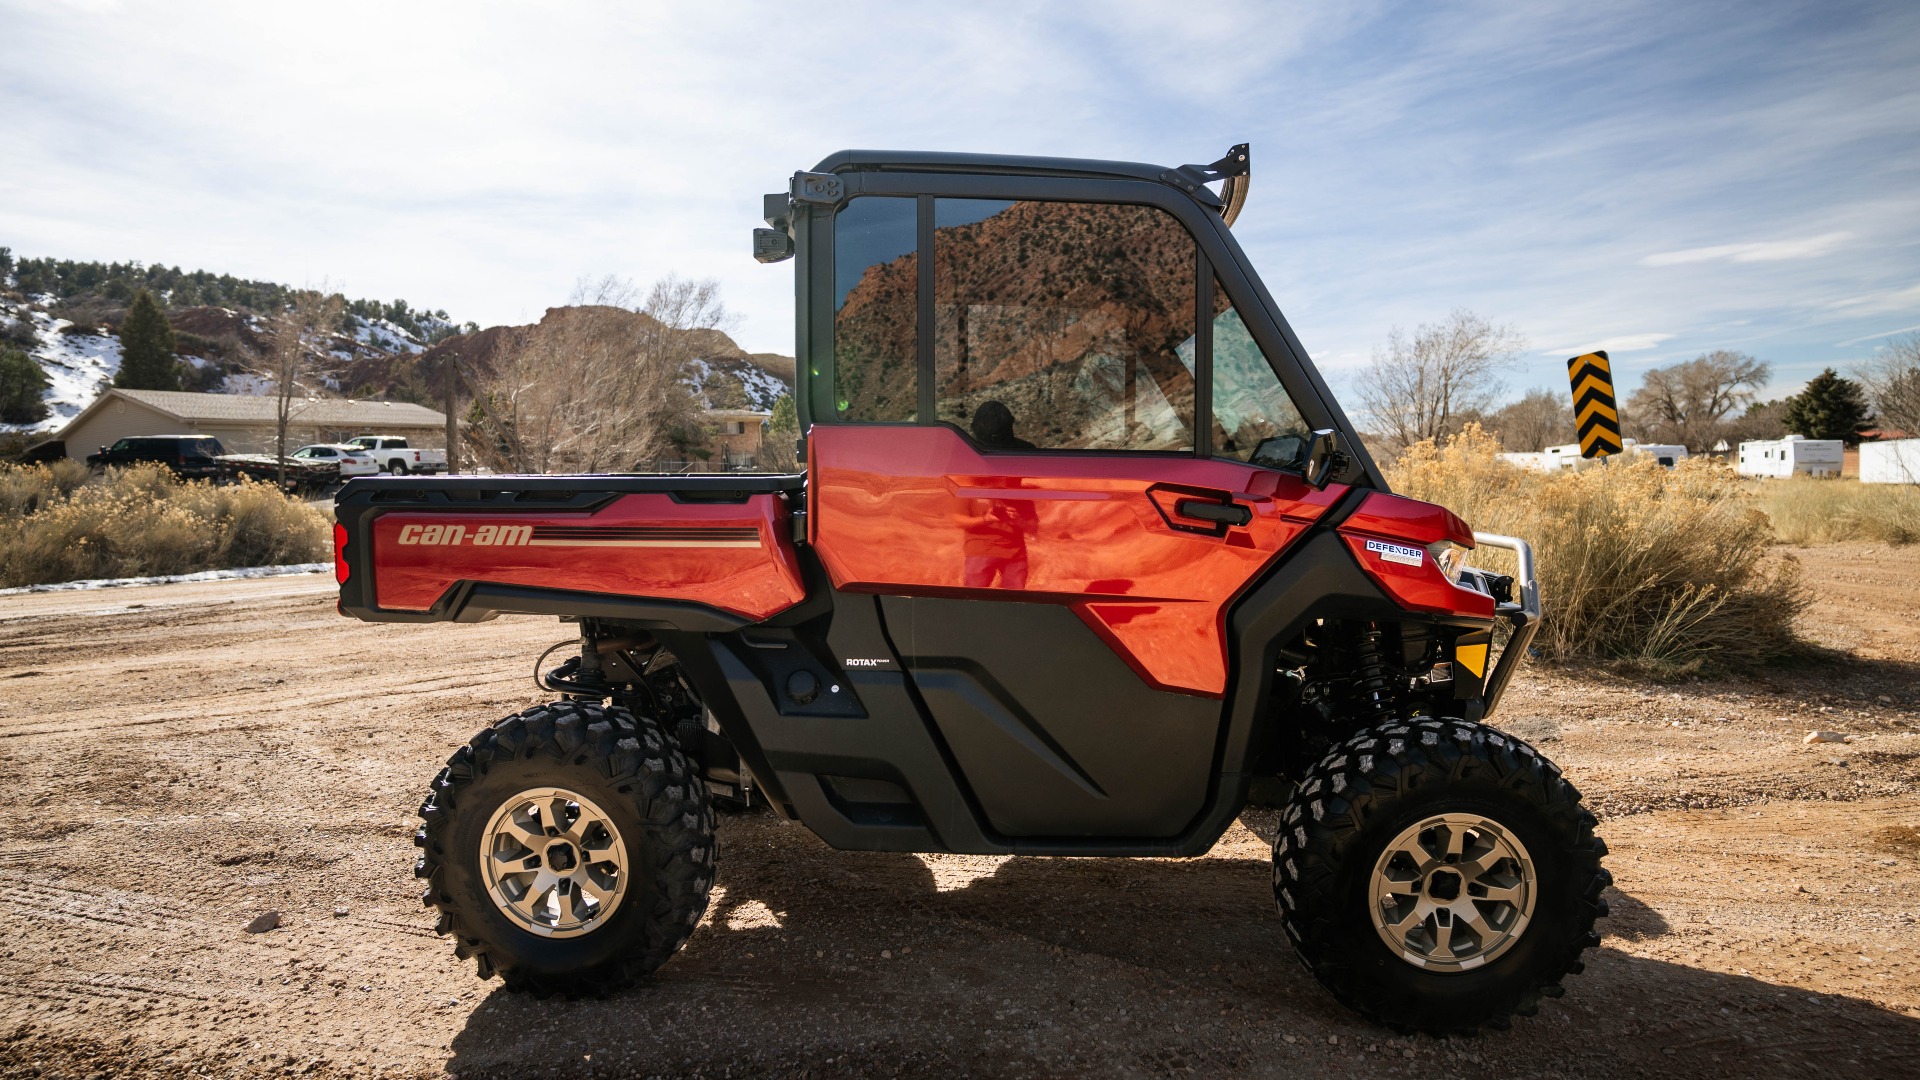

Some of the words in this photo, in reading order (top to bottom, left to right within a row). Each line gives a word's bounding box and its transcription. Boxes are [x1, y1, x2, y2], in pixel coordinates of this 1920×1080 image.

[398, 524, 533, 546] can-am
[1368, 541, 1422, 558] DEFENDER
[846, 658, 877, 666] ROTAX
